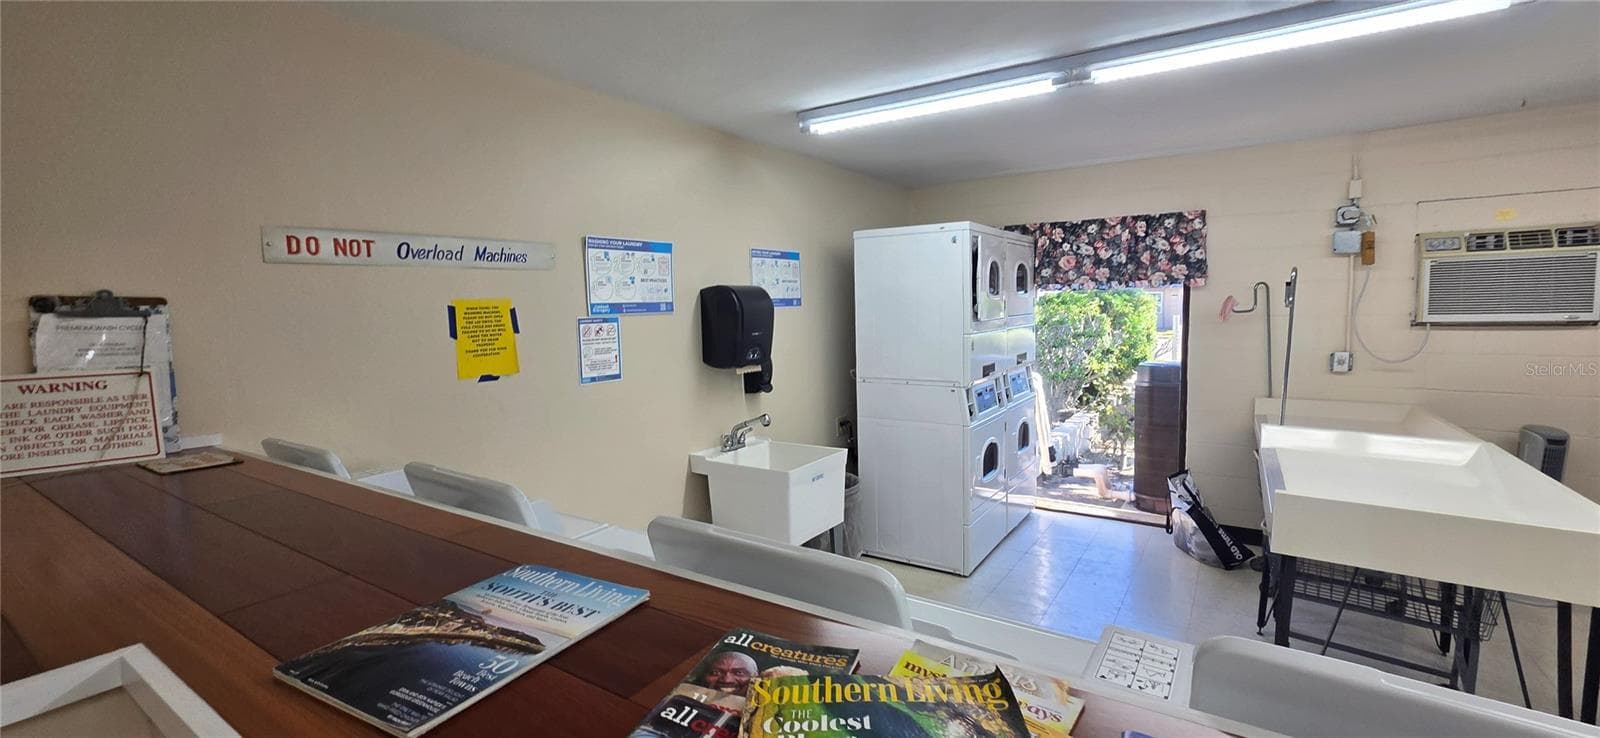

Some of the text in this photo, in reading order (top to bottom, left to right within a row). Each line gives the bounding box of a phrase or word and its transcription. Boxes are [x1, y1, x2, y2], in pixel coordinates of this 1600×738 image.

[285, 234, 528, 264] DO NOT Overload Machines
[17, 380, 108, 394] WARNING
[5, 393, 148, 411] ARE RESPONSIBLE AS USER
[28, 406, 83, 417] LAUNDRY
[88, 401, 149, 412] EQUIPMENT
[43, 415, 75, 423] EACH
[80, 411, 123, 420] WASHER
[127, 409, 150, 417] AND
[9, 435, 30, 443] INK
[35, 433, 51, 441] OR
[55, 430, 93, 439] OTHER
[96, 426, 125, 435] SUCH
[23, 426, 45, 434] FOR
[14, 441, 65, 452] OBJECTS
[93, 431, 153, 443] MATERIALS
[27, 445, 87, 459] INSERTING
[504, 564, 581, 594] Southern
[573, 581, 637, 610] Living
[550, 600, 601, 618] BEST
[723, 633, 754, 648] all
[750, 641, 848, 668] creatures
[478, 655, 520, 675] 50
[452, 669, 481, 684] Beach
[475, 669, 499, 682] Best
[449, 676, 479, 693] Towns
[751, 675, 1010, 711] Southern Living
[660, 705, 698, 727] all
[791, 709, 813, 719] THE
[763, 714, 872, 734] Coolest
